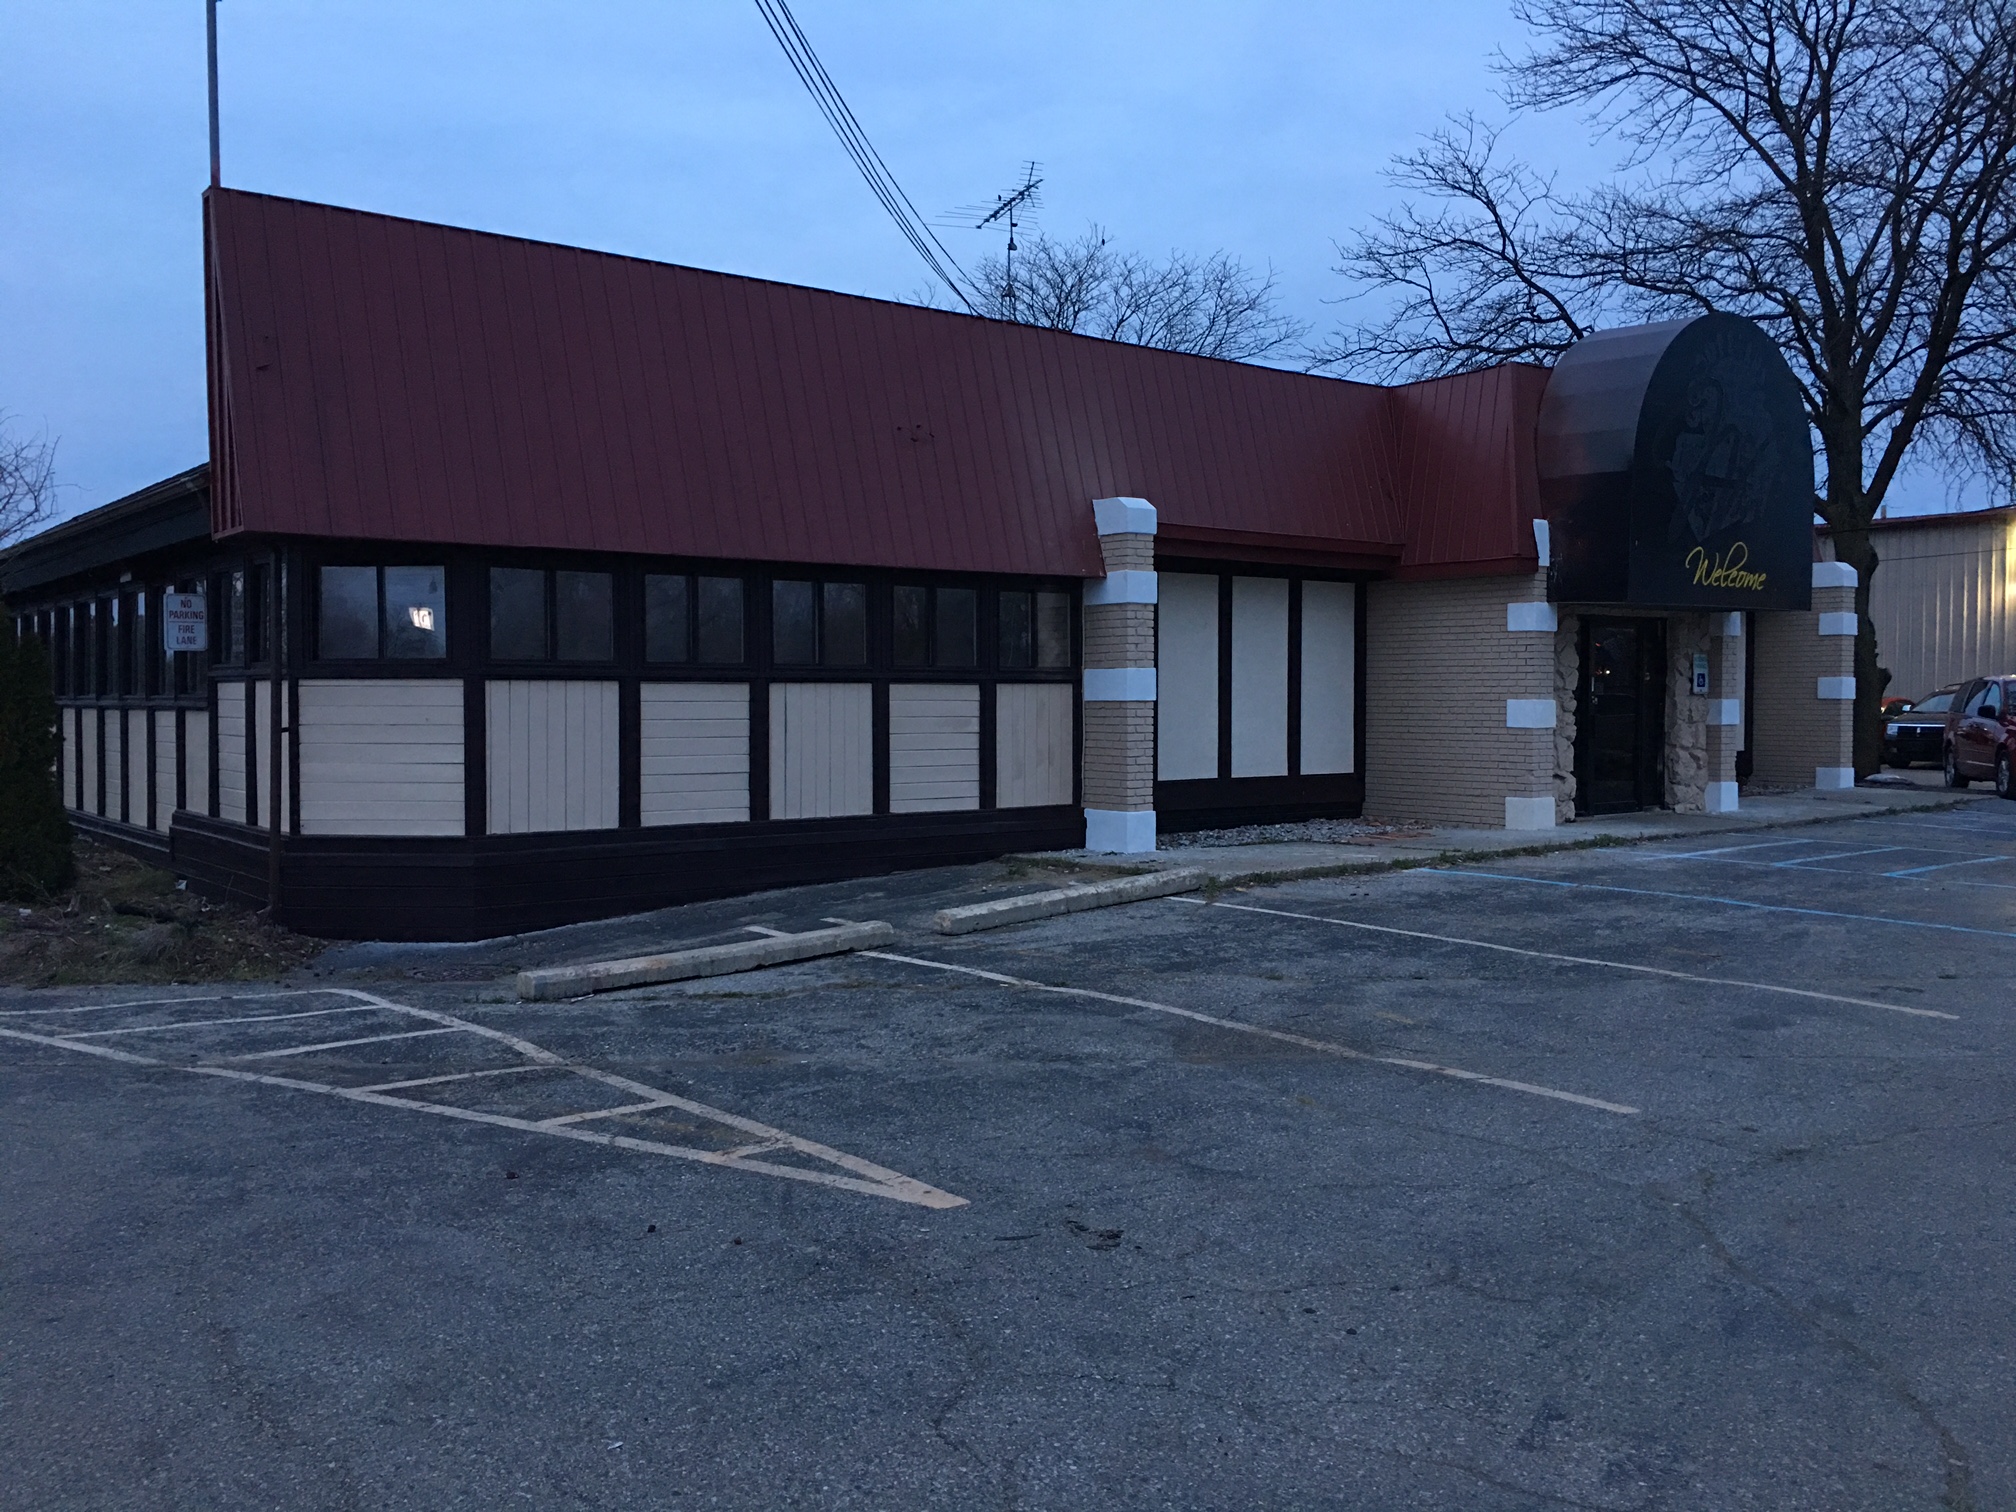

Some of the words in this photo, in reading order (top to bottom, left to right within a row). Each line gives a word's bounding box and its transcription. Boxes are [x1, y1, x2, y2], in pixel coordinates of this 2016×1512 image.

[1685, 541, 1767, 590] Welcome
[180, 600, 192, 608] NO
[169, 610, 204, 620] PARKING
[178, 625, 195, 634] FIRE
[176, 636, 197, 645] LANE
